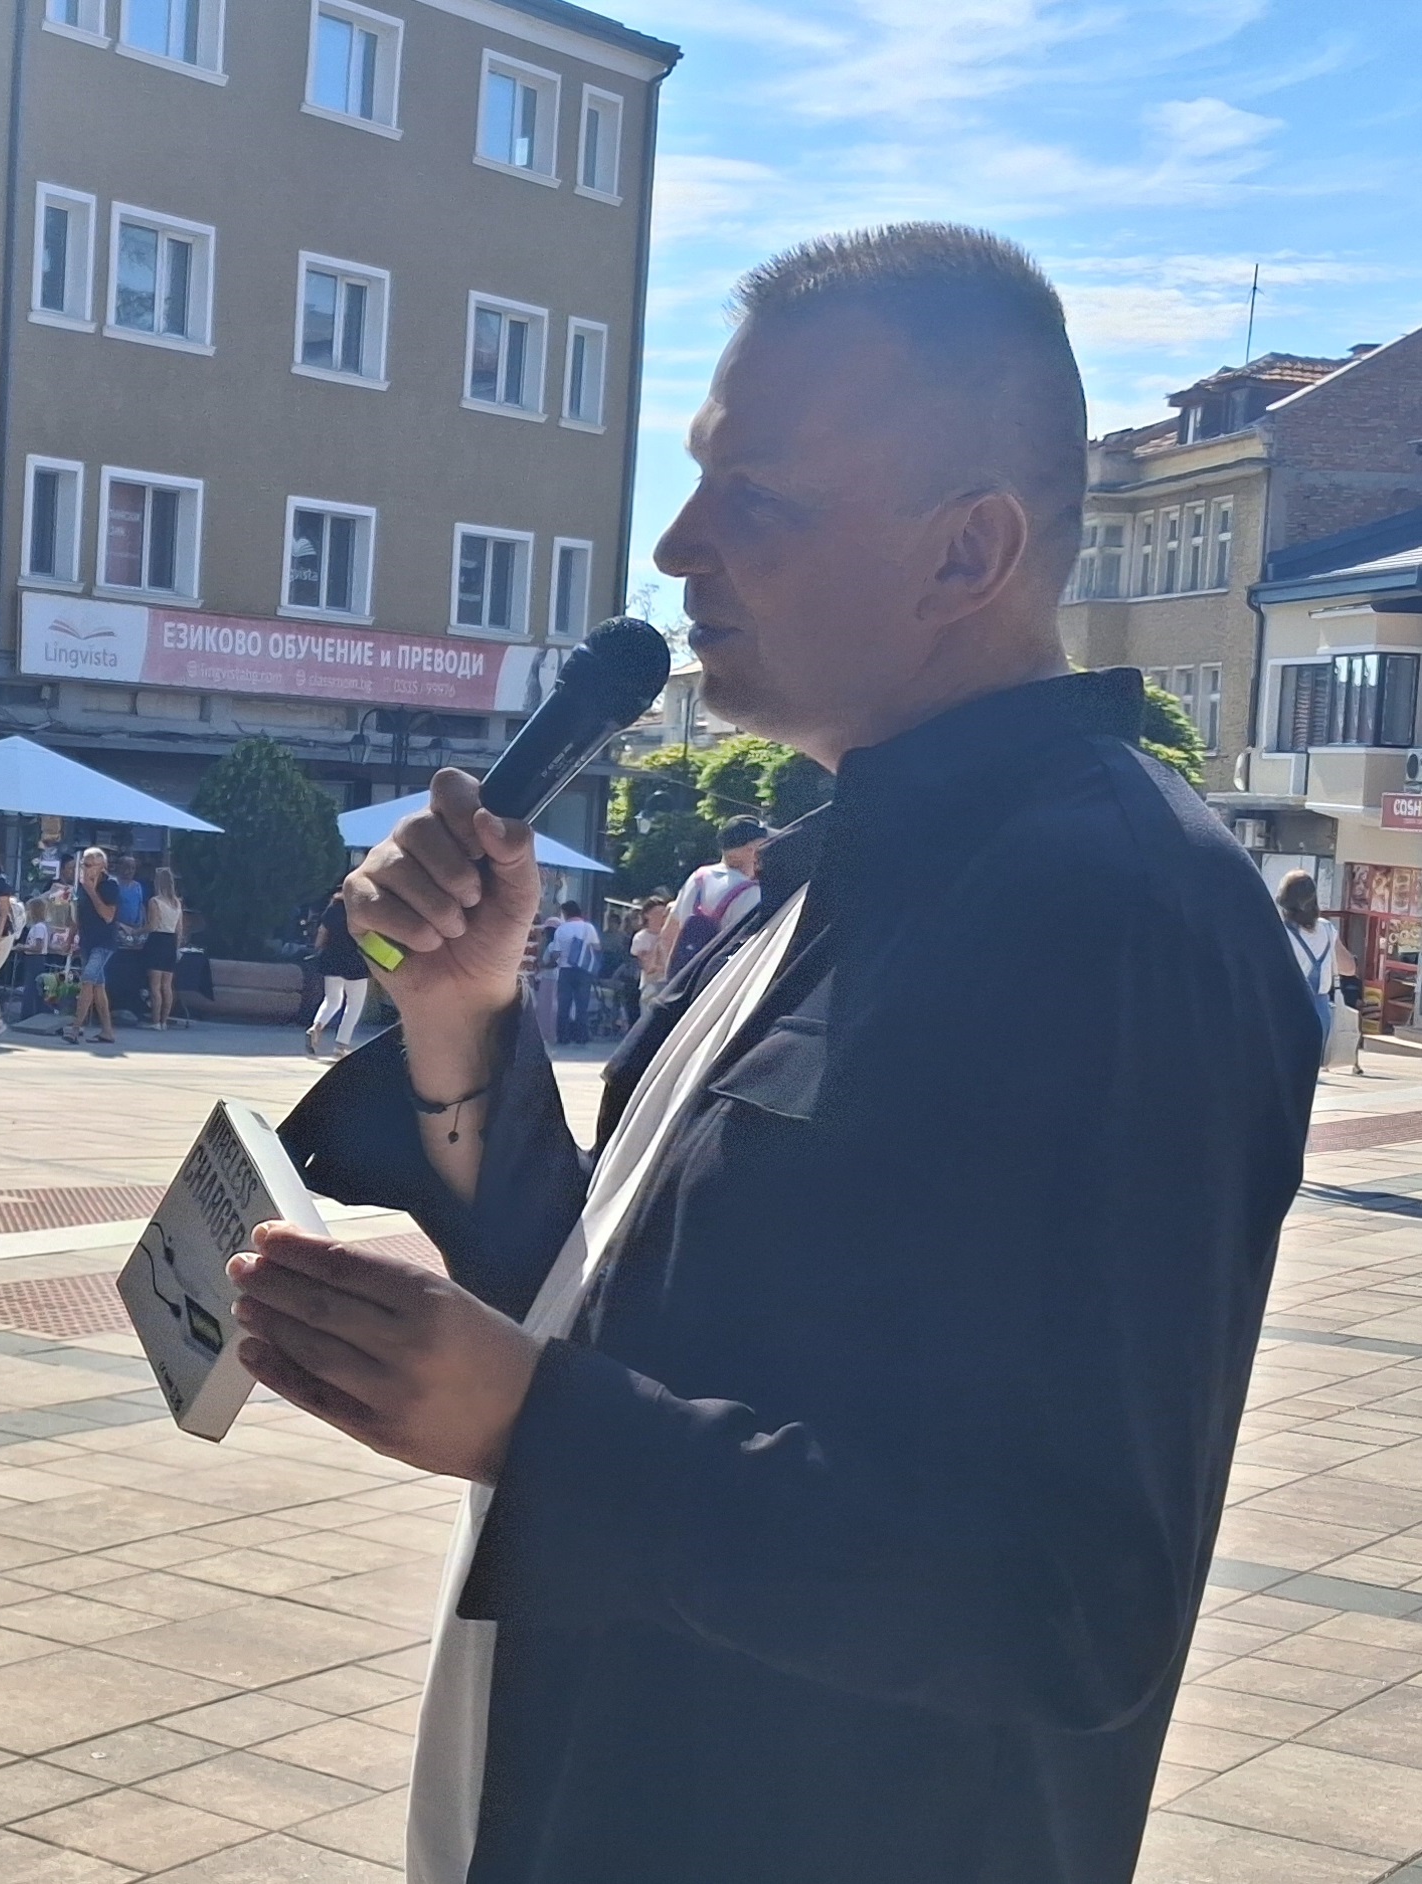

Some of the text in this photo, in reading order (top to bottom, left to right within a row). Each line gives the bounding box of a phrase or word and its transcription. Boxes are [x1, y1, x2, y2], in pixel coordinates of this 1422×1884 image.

[44, 642, 118, 669] Lingvista
[162, 621, 486, 679] ЕЗИКОВО ОБУЧЕНИЕ и ПРЕВОДИ
[205, 1106, 257, 1210] WIRELESS
[182, 1143, 246, 1257] CHARGER
